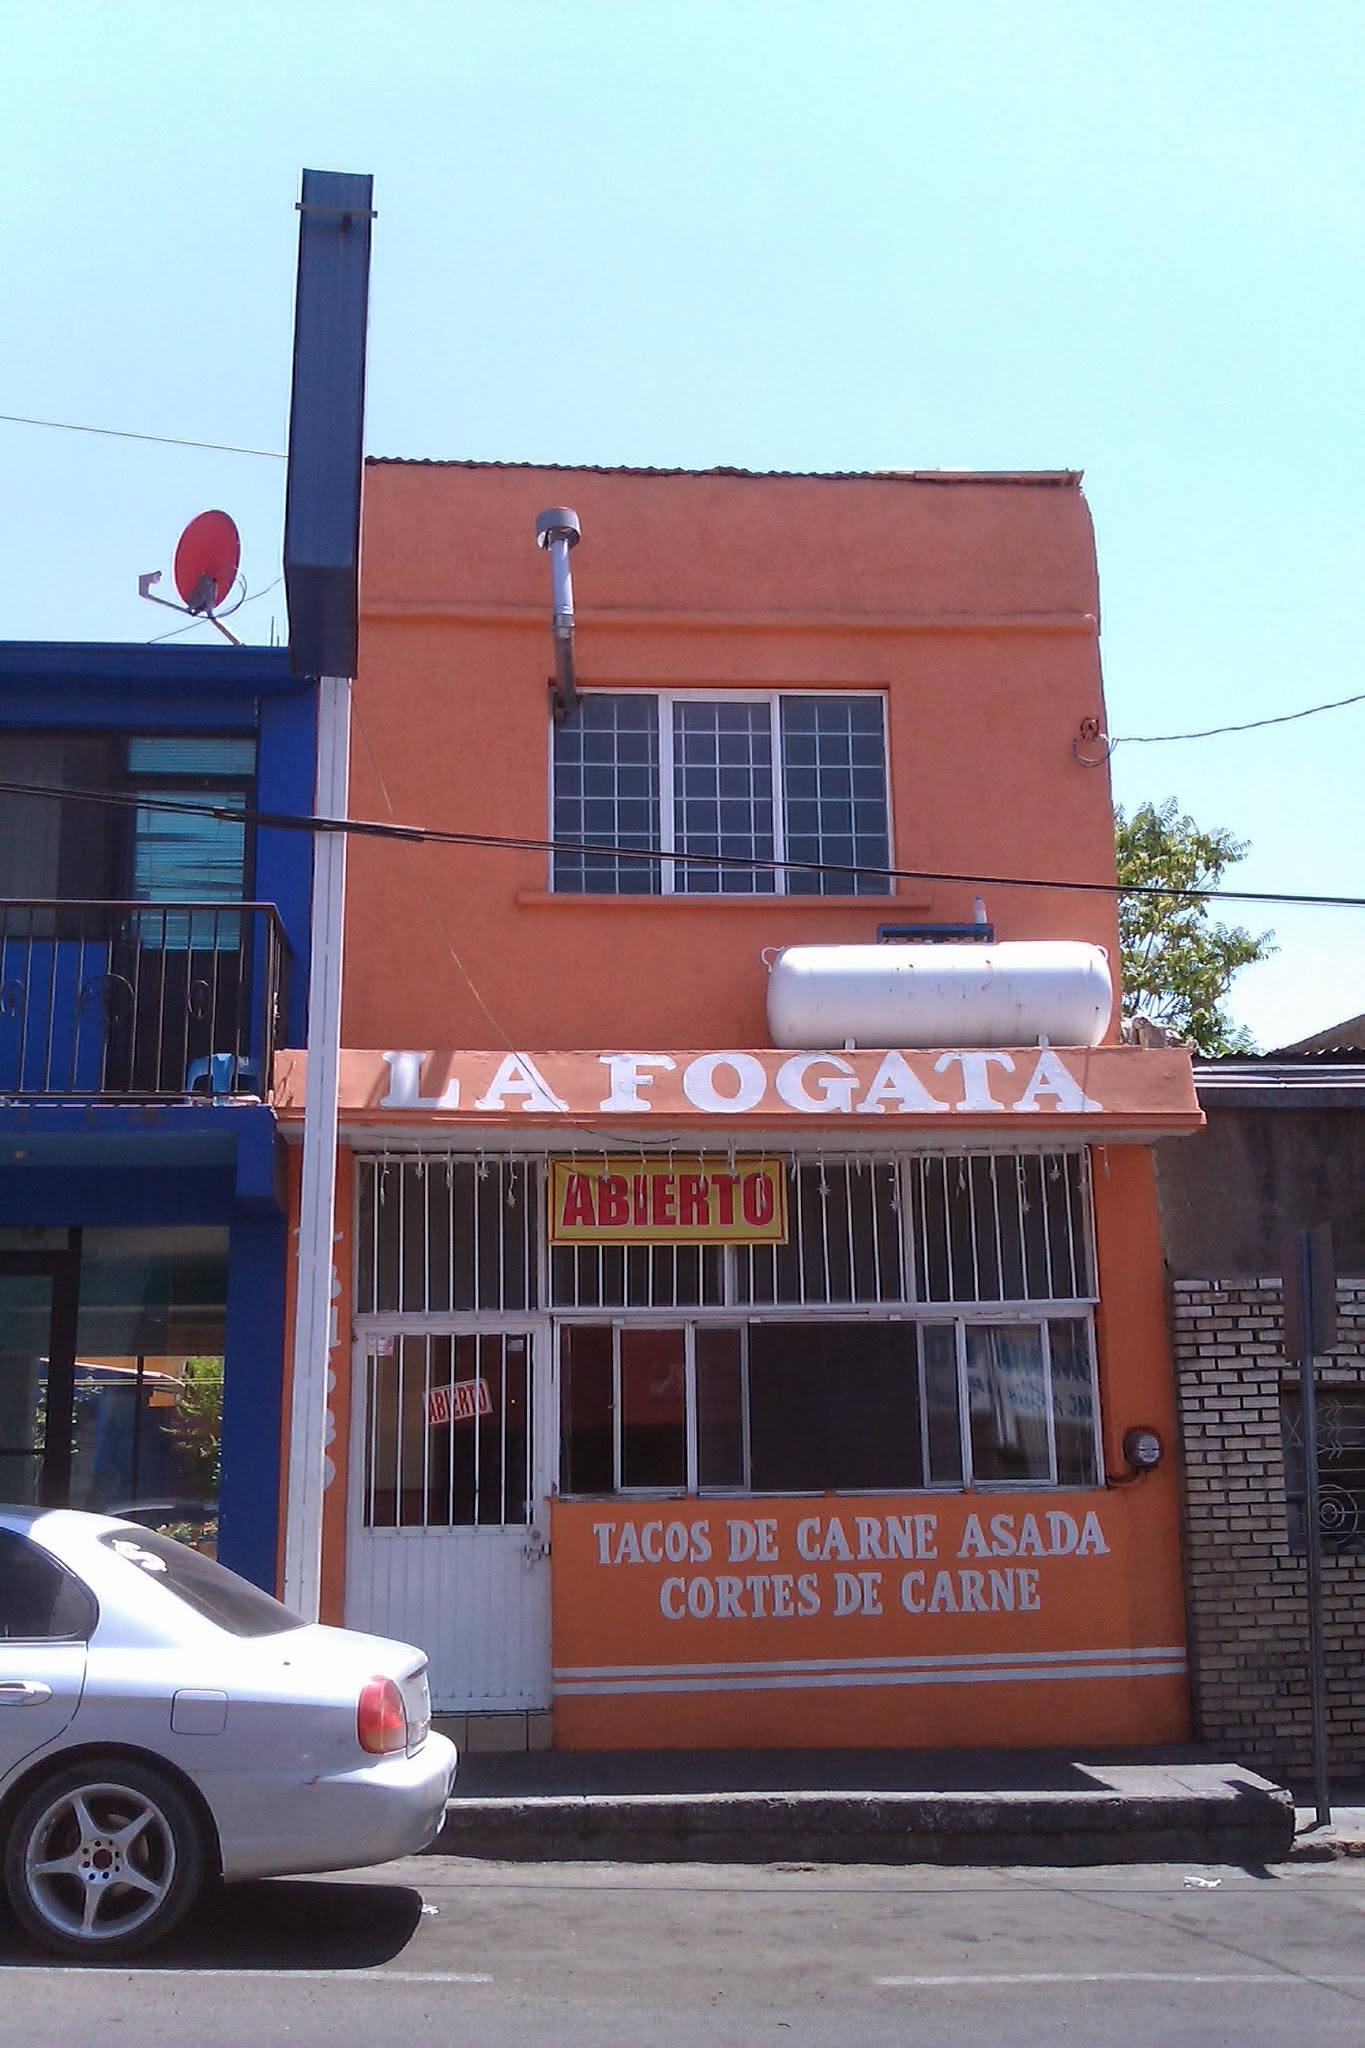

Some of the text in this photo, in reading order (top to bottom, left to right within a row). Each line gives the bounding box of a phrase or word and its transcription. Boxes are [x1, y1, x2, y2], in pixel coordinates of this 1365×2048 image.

[381, 1051, 1103, 1113] LA FOGATA
[561, 1173, 774, 1227] ABIERTO
[593, 1511, 1111, 1564] TACOS DE CARNE ASADA
[660, 1568, 1041, 1620] CORTES DE CARNE
